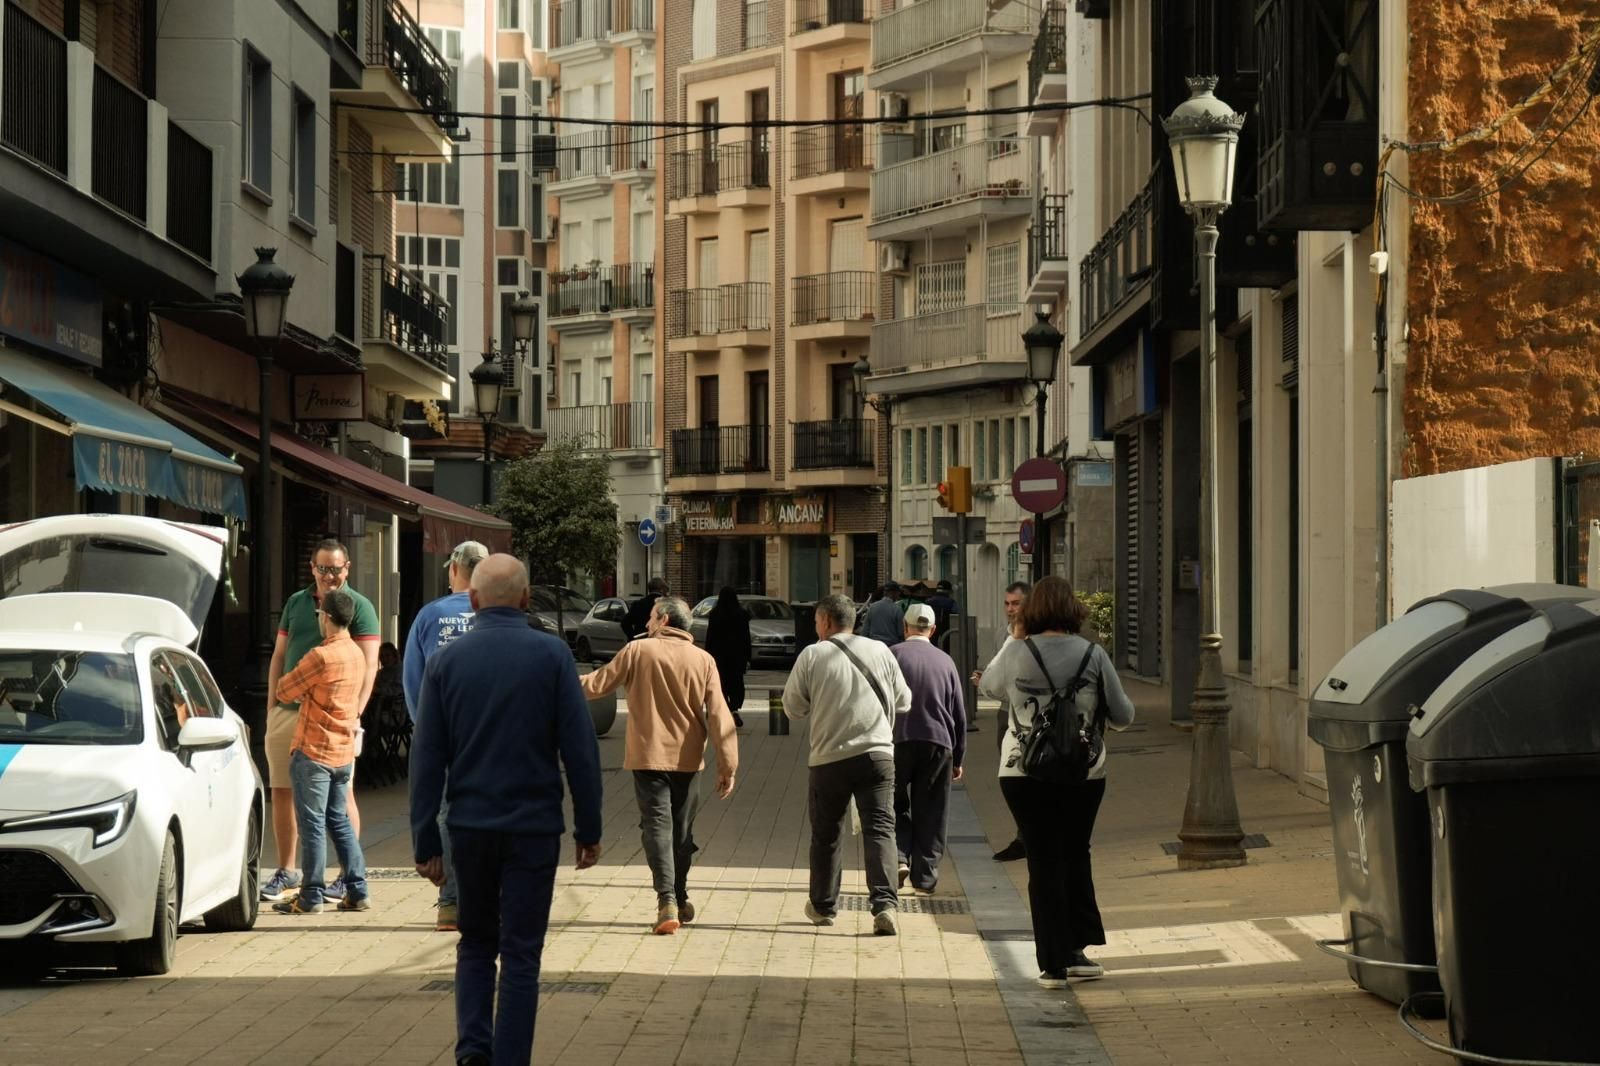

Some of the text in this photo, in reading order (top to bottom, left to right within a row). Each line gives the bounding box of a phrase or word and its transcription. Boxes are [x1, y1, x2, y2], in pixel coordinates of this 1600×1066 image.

[99, 442, 146, 490] EL ZOCO
[685, 516, 735, 530] VETERINARIA
[438, 616, 470, 625] NUEVO
